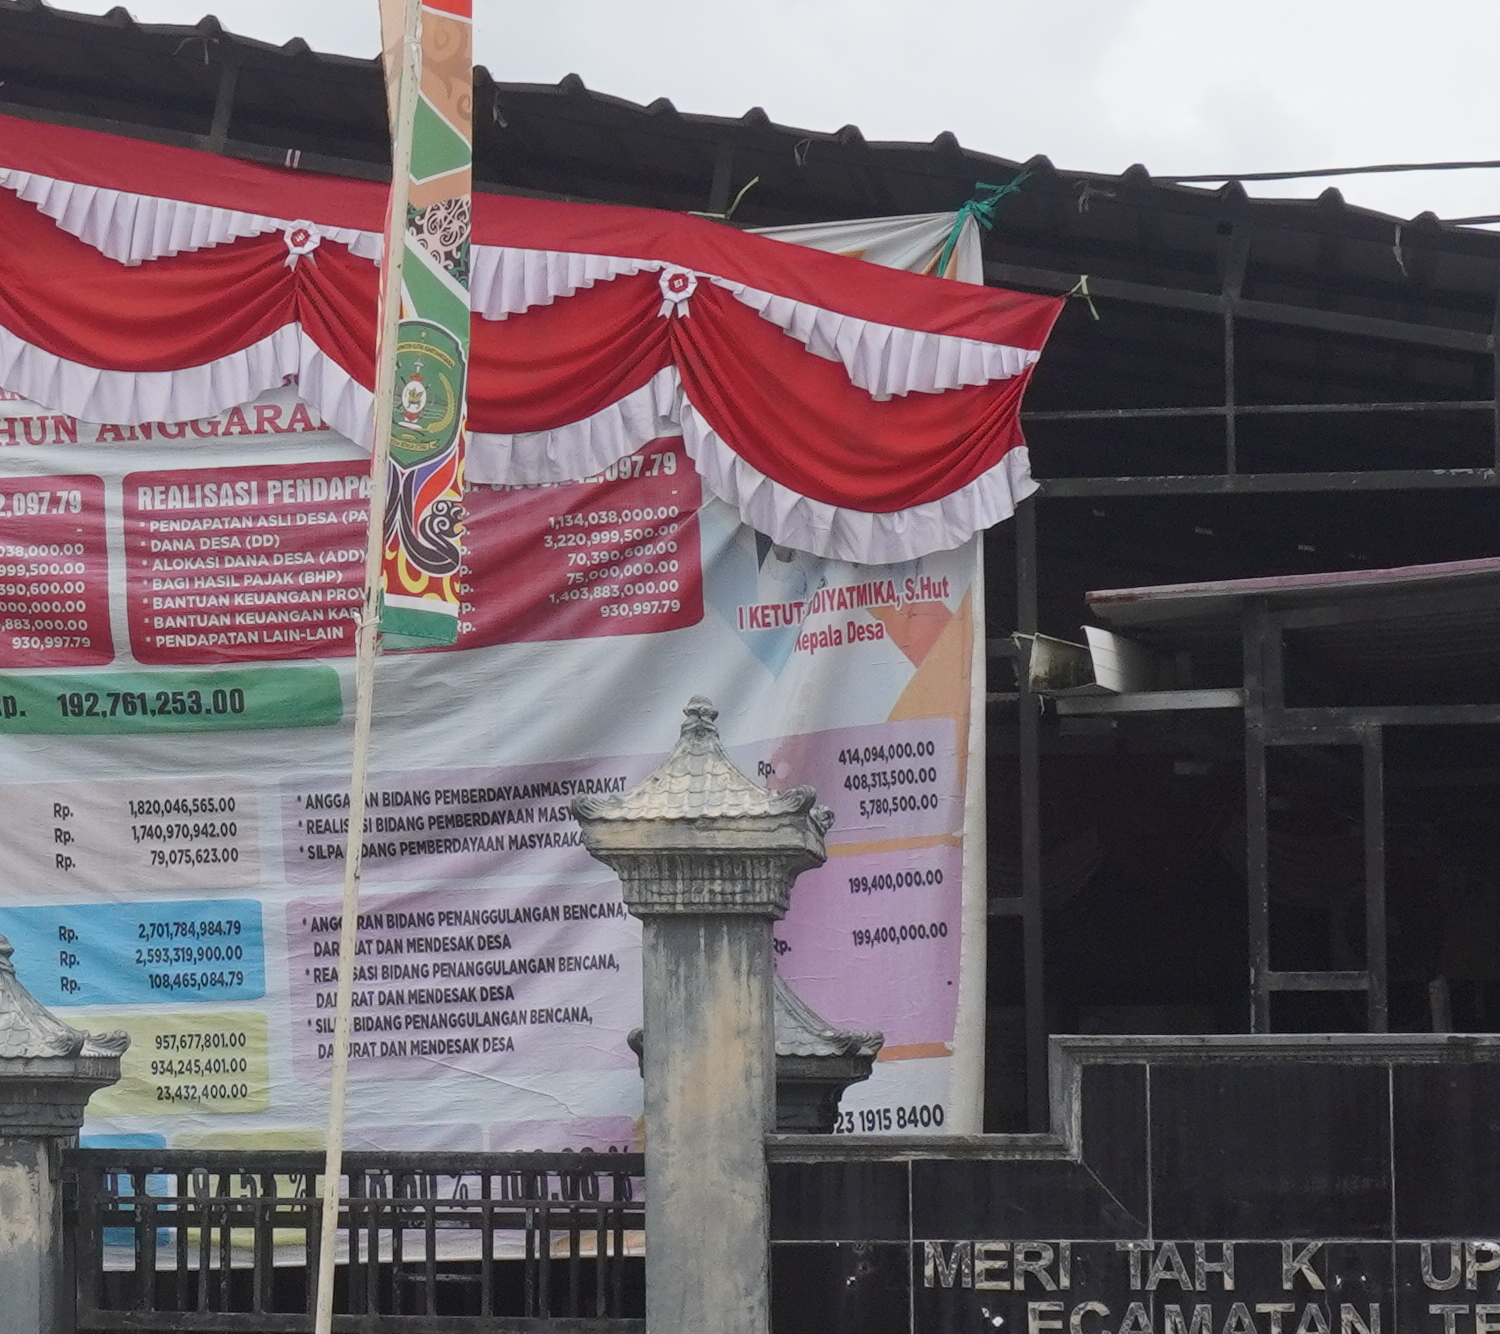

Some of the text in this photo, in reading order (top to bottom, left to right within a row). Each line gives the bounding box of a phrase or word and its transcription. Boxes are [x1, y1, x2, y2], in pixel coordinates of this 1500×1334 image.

[137, 481, 260, 511] REALISASI
[149, 512, 339, 534] PENDAPATAN ASLI DESA
[152, 570, 343, 592] BAGI HASIL PAJAK (BHP)
[153, 591, 323, 611] BANTUAN KEUANGAN
[749, 603, 803, 629] KETUT
[904, 576, 950, 602] S.Hut
[153, 609, 324, 630] BANTUAN KEUANGAN
[155, 626, 344, 650] PENDAPATAN LAIN-LAIN
[846, 621, 885, 643] Desa
[12, 635, 91, 651] 930,997.79
[56, 688, 245, 720] 192,761,253.00
[838, 740, 936, 767] 414,094,000.00
[843, 766, 938, 792] 408,313,500.00
[128, 796, 236, 817] 1,820,046,565.00
[859, 793, 939, 818] 5,780,500.00
[131, 822, 238, 842] 1,740,970,942.00
[375, 815, 425, 833] BIDANG
[150, 847, 239, 868] 79,075,623.00
[848, 868, 944, 895] 199,400,000.00
[438, 901, 628, 928] PENANGGULANGAN BENCANA,
[138, 920, 242, 940] 2,701,784,984.79
[135, 945, 244, 966] 2,593,319,900.00
[149, 970, 245, 990] 108,465,084.79
[155, 1032, 247, 1051] 957,677,801.00
[150, 1058, 248, 1076] 934,245,401.00
[156, 1083, 248, 1103] 23,432,400.00
[858, 1102, 945, 1133] 1915 8400
